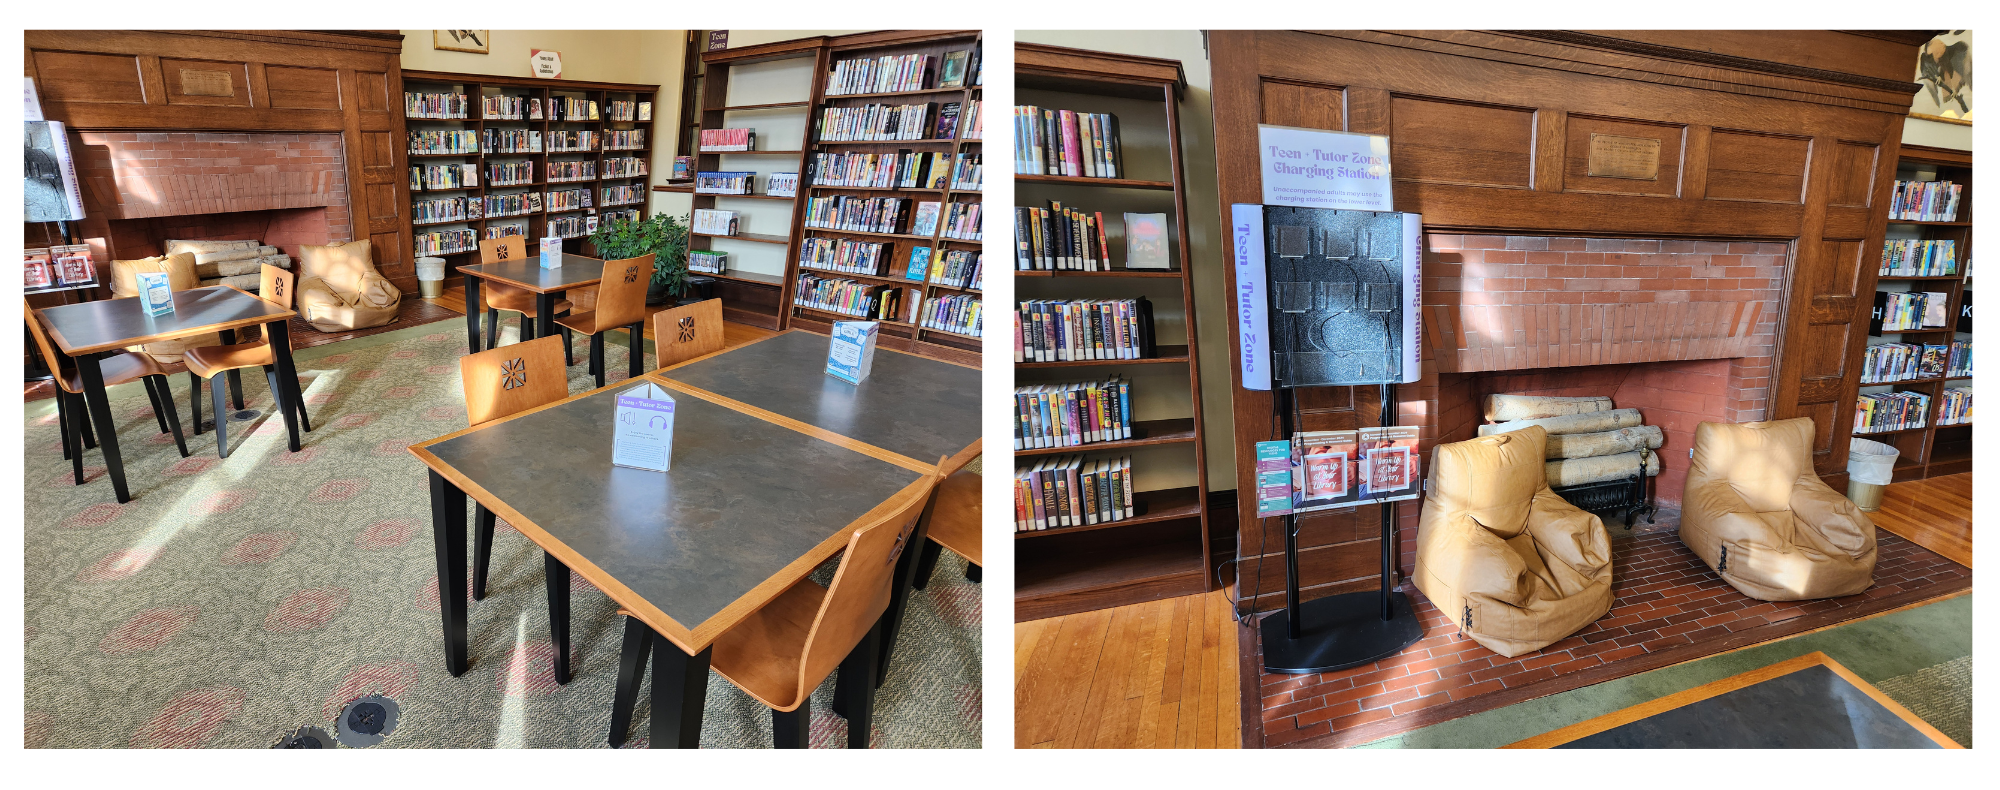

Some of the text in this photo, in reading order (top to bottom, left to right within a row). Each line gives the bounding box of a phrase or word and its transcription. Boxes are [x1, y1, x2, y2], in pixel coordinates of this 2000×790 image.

[1269, 146, 1301, 159] Teen
[1313, 149, 1348, 163] Tutor
[1352, 151, 1381, 165] Zone
[1273, 161, 1380, 180] Charging Station
[1273, 186, 1325, 196] Unaccompanied
[1276, 195, 1304, 203] charging
[1237, 223, 1250, 266] Teen
[1241, 281, 1254, 329] Tutor
[1412, 235, 1422, 363] Charging Station
[1872, 306, 1882, 320] H
[1962, 305, 1973, 318] K
[1243, 333, 1257, 373] Zone
[1310, 462, 1339, 473] Warm Up
[1393, 457, 1402, 466] Up
[1321, 471, 1336, 480] Your
[1378, 474, 1400, 483] Library
[1313, 480, 1337, 490] Library
[1044, 489, 1055, 511] FINALE
